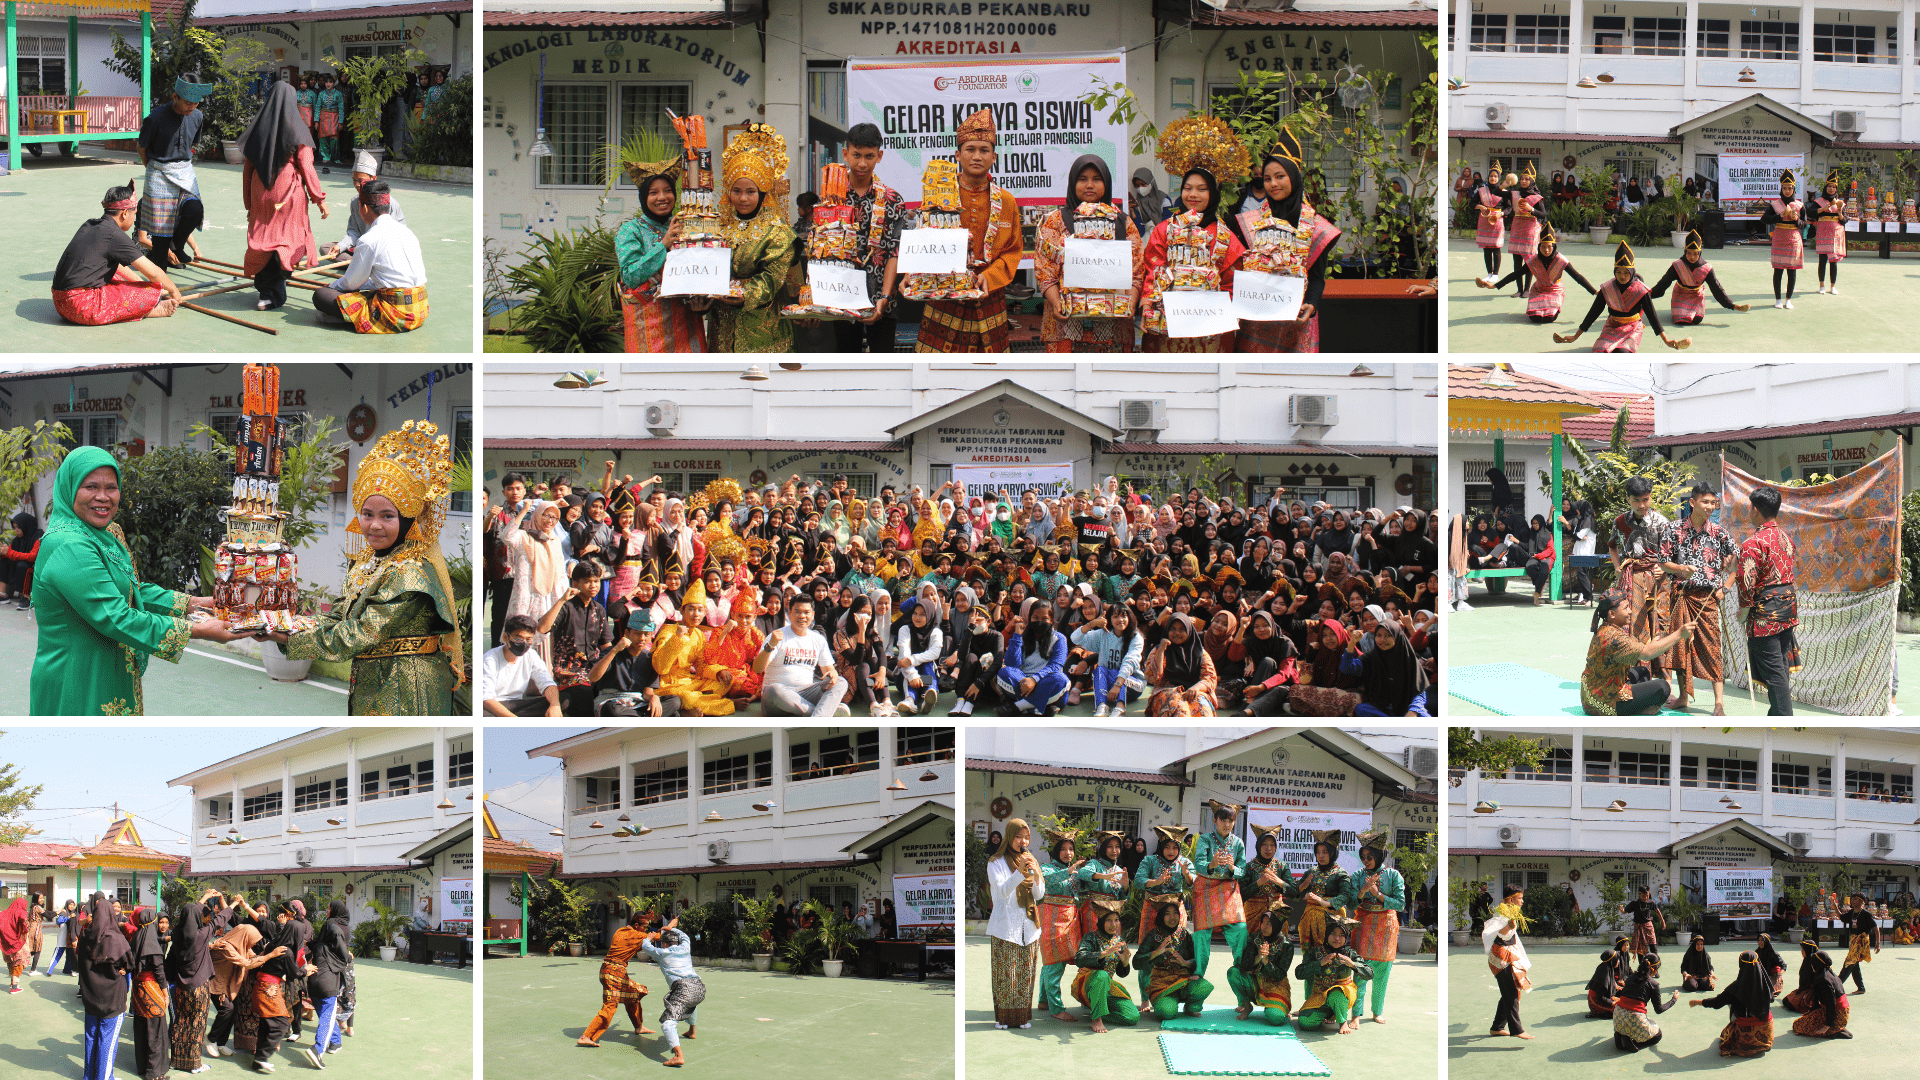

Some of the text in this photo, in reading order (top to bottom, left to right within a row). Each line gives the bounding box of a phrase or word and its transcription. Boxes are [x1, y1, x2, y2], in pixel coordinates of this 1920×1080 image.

[828, 2, 1090, 16] SMK ABDURRAB PEKANBARU
[861, 21, 1057, 36] NPP.1471081H2000006
[266, 26, 299, 49] KOMUNITA
[341, 30, 412, 43] FARMASI CORNER
[895, 40, 1022, 54] AKREDITASI A
[1225, 34, 1352, 62] ENGLISH
[483, 30, 751, 86] KNOLOGI LABORATORIUM
[1240, 57, 1341, 71] CORNER
[572, 59, 651, 73] MEDIK
[958, 74, 1007, 83] ABDURRAB
[958, 82, 1007, 90] FOUNDATION
[884, 104, 945, 134] GELAR
[1025, 101, 1092, 130] SISWA
[884, 136, 917, 149] PROJEK
[920, 135, 957, 148] PENGUAT
[1005, 133, 1042, 146] PELAJAR
[1045, 132, 1092, 145] PANCASILA
[1505, 147, 1541, 155] CORNER
[1004, 153, 1046, 173] LOKAL
[1729, 168, 1770, 177] GELAR KARYA
[1000, 175, 1052, 188] PEKANBARU
[905, 244, 957, 254] JUARA 3
[1071, 257, 1116, 266] HARAPAN
[669, 265, 709, 277] JUARA
[816, 280, 860, 295] JUARA 2
[1239, 290, 1285, 303] HARAPAN
[1172, 308, 1217, 316] HARAPAN
[387, 363, 472, 408] TEKNOLO
[54, 397, 122, 413] FARMASI CORNER
[210, 395, 233, 408] TLM
[938, 428, 1006, 436] PERPUSTAKAAN
[1008, 428, 1046, 436] TABRANI
[940, 436, 1063, 445] SMK ABDURRAB PEKANBARU
[972, 454, 1023, 463] AKREDITASI
[1797, 448, 1866, 463] FARMASI CORNER
[538, 458, 577, 468] CORNER
[652, 460, 722, 469] TLM CORNER
[1083, 528, 1108, 538] BELAJAR
[785, 647, 817, 658] MERDEKA
[1211, 763, 1346, 781] PERPUSTAKAAN TABRANI RAB
[1213, 773, 1343, 790] SMK ABDURRAB PEKANBARU
[1014, 778, 1173, 814] TEKNOLOGI LABORATORIUM
[1077, 793, 1120, 803] MEDIK
[1230, 785, 1326, 799] NPP.1471081H2000006
[1246, 796, 1301, 806] AKREDITASI
[1284, 852, 1314, 862] KEARIFAN
[728, 879, 756, 887] CORNER
[451, 891, 468, 899] GELAR
[905, 889, 952, 901] GELAR KARYA
